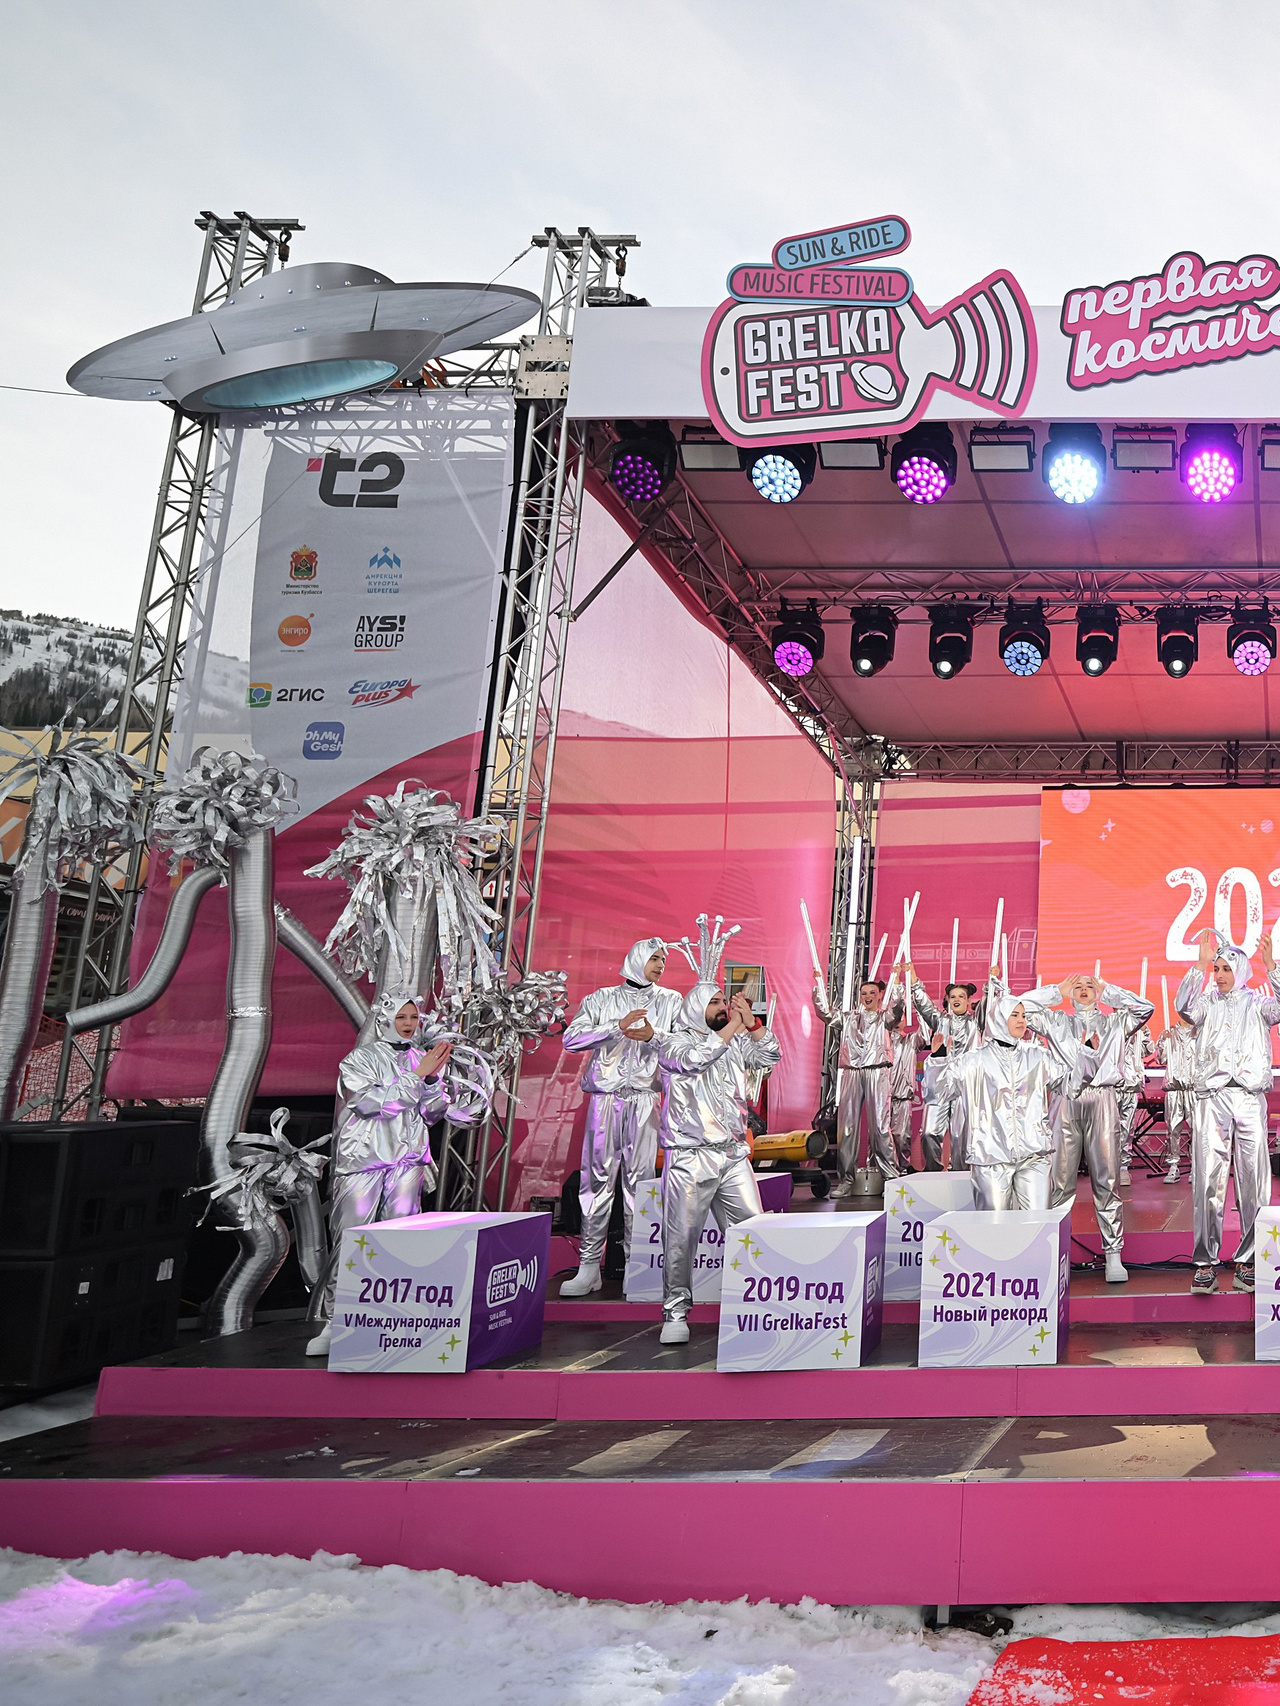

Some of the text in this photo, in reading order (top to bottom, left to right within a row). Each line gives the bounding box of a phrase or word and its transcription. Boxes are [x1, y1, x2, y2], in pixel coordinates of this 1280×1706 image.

[786, 224, 894, 266] SUN & RIDE
[743, 271, 897, 297] MUSIC FESTIVAL
[1066, 256, 1275, 329] первая
[744, 307, 891, 365] GRELKA
[747, 362, 846, 416] FEST
[306, 447, 405, 509] t2
[355, 615, 407, 632] AYS!
[354, 633, 404, 648] GROUP
[276, 688, 325, 702] 2ГИС
[305, 731, 340, 743] Oh My
[310, 741, 344, 752] Gesh
[492, 1265, 518, 1286] GRELKA
[942, 1271, 996, 1298] 2021
[1001, 1277, 1040, 1300] год
[358, 1277, 454, 1307] 2017 год
[490, 1283, 509, 1301] FEST
[743, 1275, 845, 1304] 2019 год
[344, 1313, 461, 1333] V Международная
[737, 1313, 759, 1332] VII
[762, 1311, 848, 1332] GrelkaFest
[933, 1305, 987, 1323] Новый
[990, 1307, 1048, 1326] рекорд
[378, 1333, 422, 1352] Грелка
